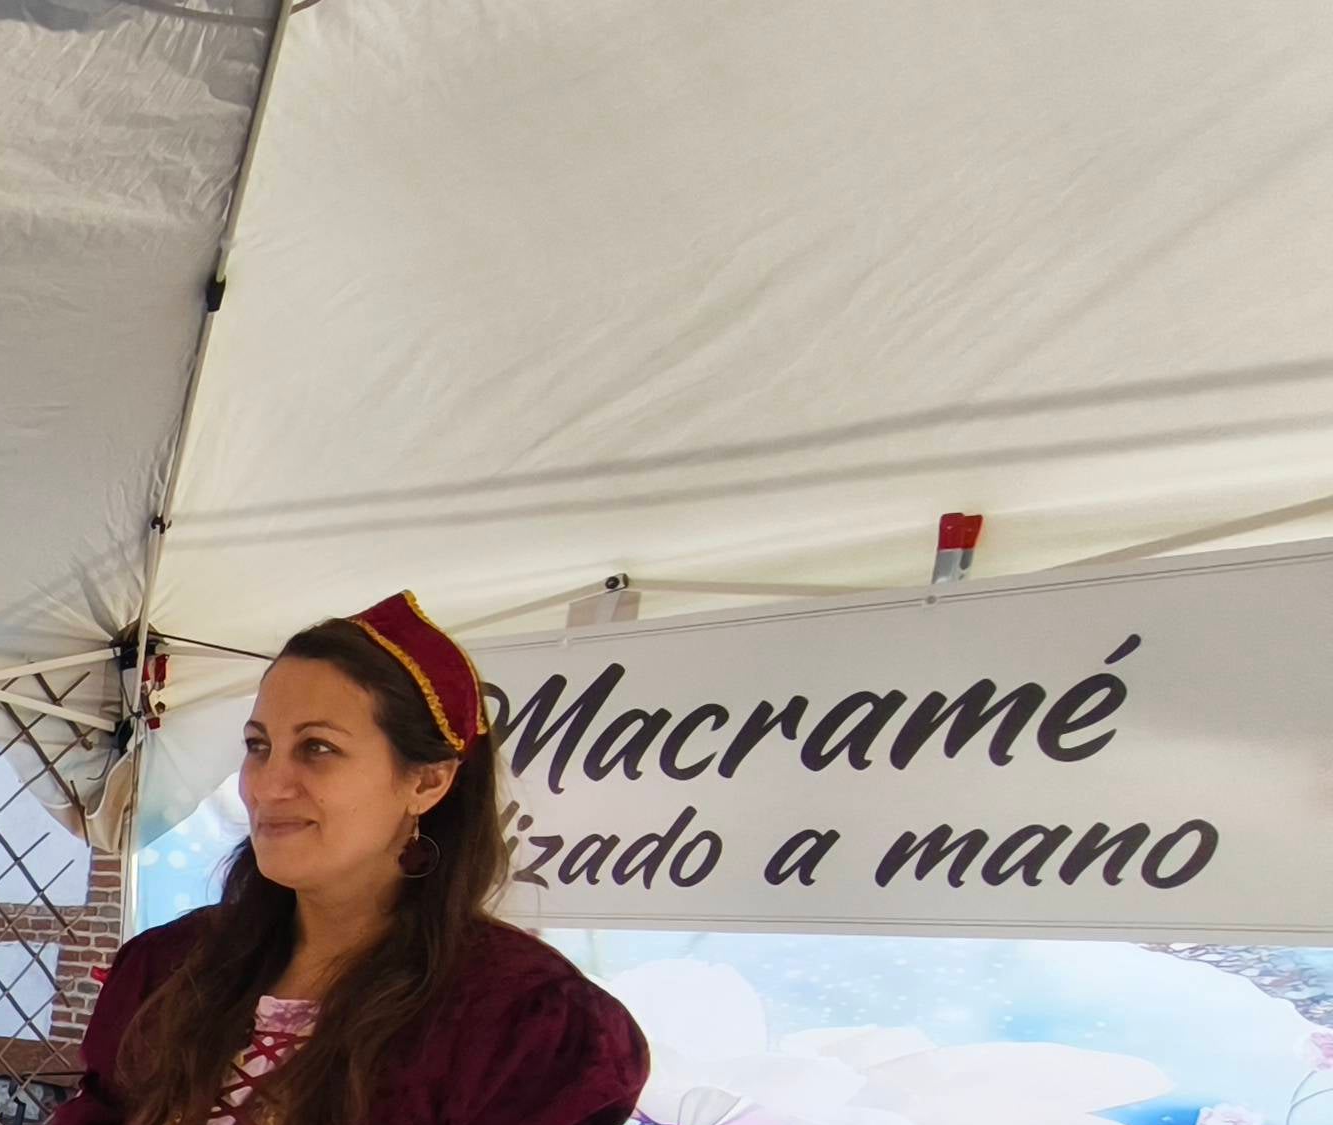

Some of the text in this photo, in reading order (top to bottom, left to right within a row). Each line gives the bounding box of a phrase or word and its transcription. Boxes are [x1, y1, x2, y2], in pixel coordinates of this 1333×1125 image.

[482, 633, 1142, 795] Macramé
[763, 829, 841, 888] a
[874, 818, 1220, 890] mano
